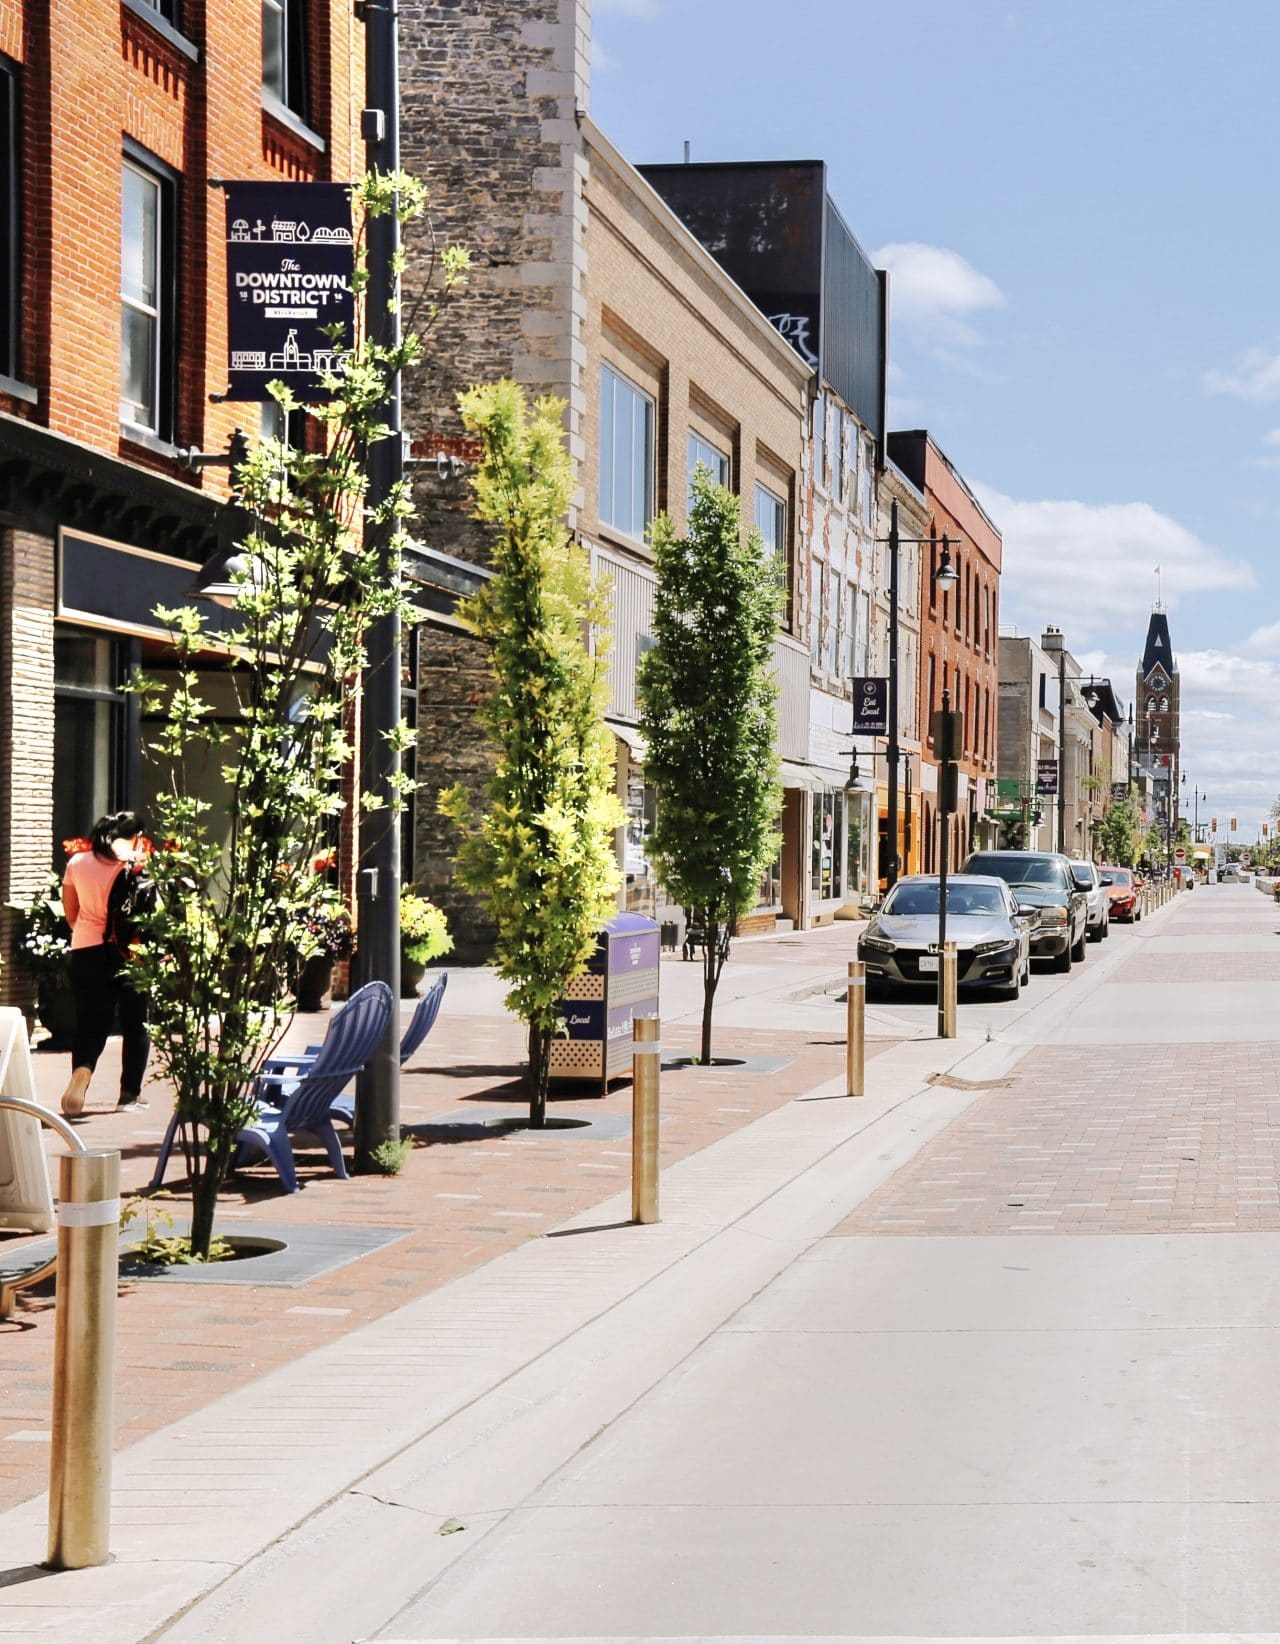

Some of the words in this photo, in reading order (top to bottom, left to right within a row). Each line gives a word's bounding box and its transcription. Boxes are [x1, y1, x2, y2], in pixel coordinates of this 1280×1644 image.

[281, 259, 300, 272] The
[235, 272, 346, 289] DOWNTOWN
[252, 289, 330, 305] DISTRICT
[864, 697, 876, 706] Eat
[860, 706, 880, 715] Local
[569, 1014, 591, 1025] Local
